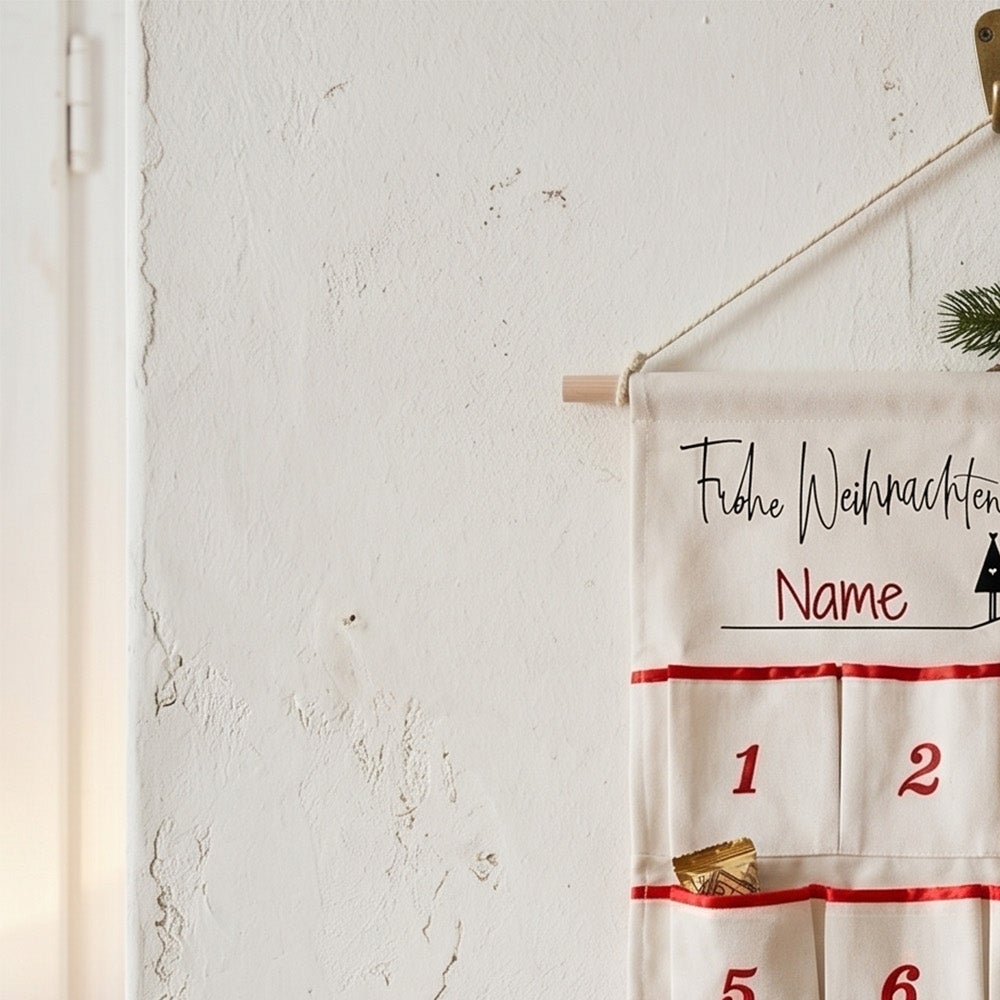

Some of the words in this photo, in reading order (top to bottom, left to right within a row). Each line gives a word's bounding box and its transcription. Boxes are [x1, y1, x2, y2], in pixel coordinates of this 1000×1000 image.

[680, 437, 784, 523] Frohe
[776, 568, 908, 622] Name
[733, 745, 758, 793] 1
[899, 743, 940, 796] 2
